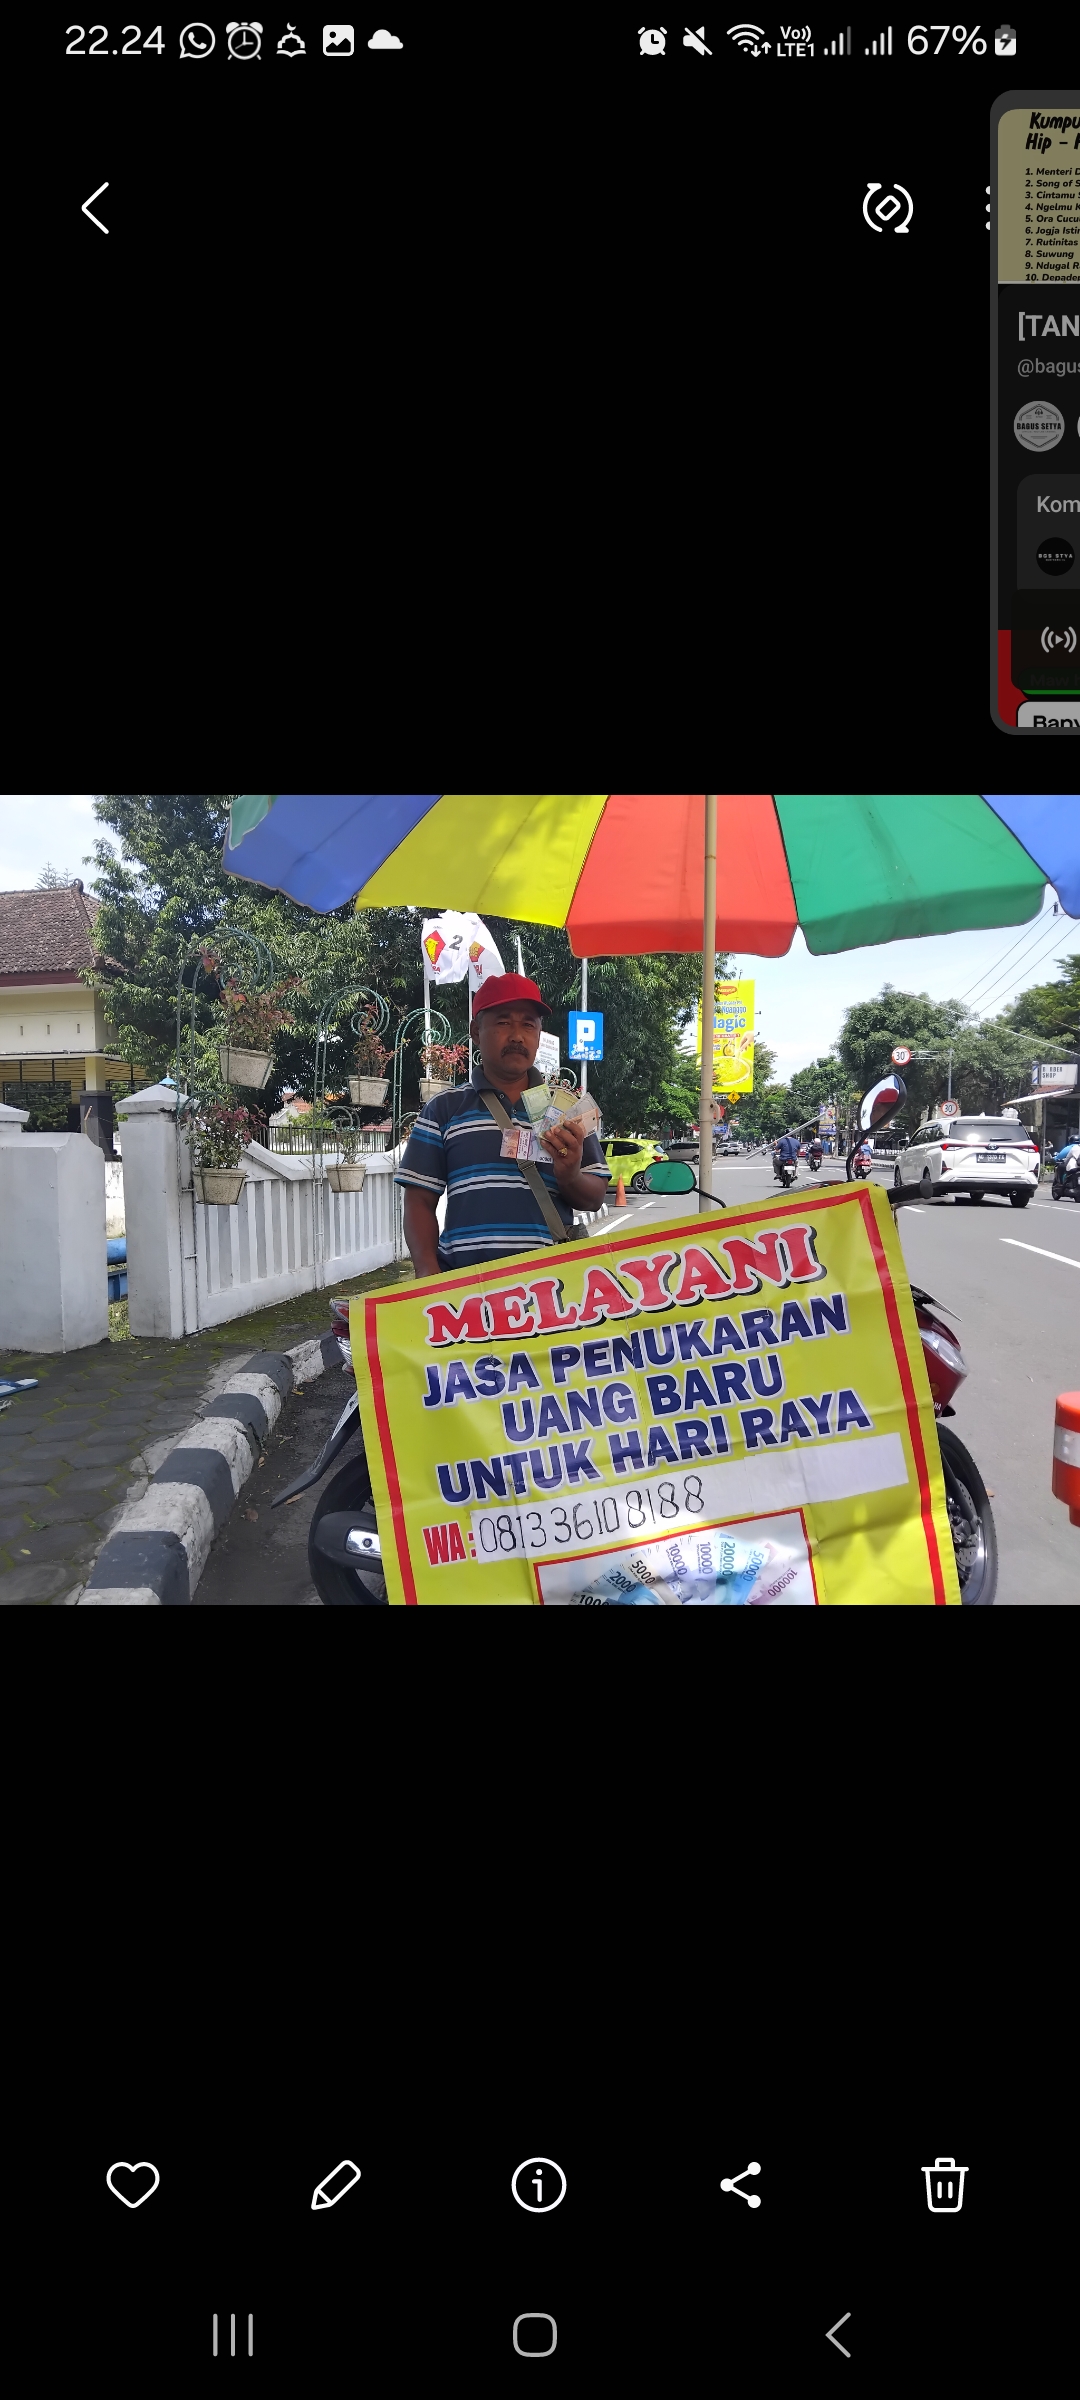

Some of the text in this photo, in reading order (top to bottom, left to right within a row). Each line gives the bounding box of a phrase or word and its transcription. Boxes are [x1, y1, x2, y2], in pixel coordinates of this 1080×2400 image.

[65, 24, 166, 56] 22.24
[777, 42, 815, 57] LTE1
[907, 24, 988, 56] 67%
[1025, 132, 1052, 155] Hip
[1025, 167, 1034, 176] 1.
[1036, 167, 1073, 176] Menteri
[1025, 179, 1034, 188] 2.
[1036, 179, 1060, 189] Song
[1062, 179, 1074, 188] of
[1025, 191, 1034, 199] 3.
[1036, 190, 1076, 199] Cintamu
[1025, 202, 1034, 211] 4.
[1036, 202, 1073, 213] Ngelmu
[1025, 214, 1034, 223] 5.
[1036, 214, 1054, 223] Ora
[1025, 226, 1034, 235] 6.
[1035, 226, 1060, 236] Jogja
[1025, 237, 1079, 246] 7. Rutinitas
[1025, 249, 1074, 260] 8. Suwung
[1025, 261, 1034, 270] 9.
[1036, 261, 1070, 271] Ndugal
[1025, 273, 1039, 282] 10.
[1018, 311, 1080, 342] [TAN
[1016, 422, 1062, 430] BAGUS SETYA
[1037, 495, 1080, 513] Kom
[448, 934, 464, 951] 2
[576, 1019, 596, 1052] P
[895, 1051, 906, 1061] 30
[944, 1104, 953, 1113] 30
[425, 1224, 825, 1346] MELAYANI
[422, 1293, 849, 1407] JASA PENUKARAN
[501, 1354, 783, 1442] UANG BARU
[436, 1389, 872, 1503] UNTUK HARI RAYA
[668, 1543, 688, 1576] 10000
[699, 1541, 714, 1575] 10000
[722, 1541, 736, 1577] 20000
[742, 1550, 765, 1582] 50000
[609, 1570, 637, 1593] 2000
[631, 1559, 656, 1584] 5000
[767, 1569, 798, 1597] 100000
